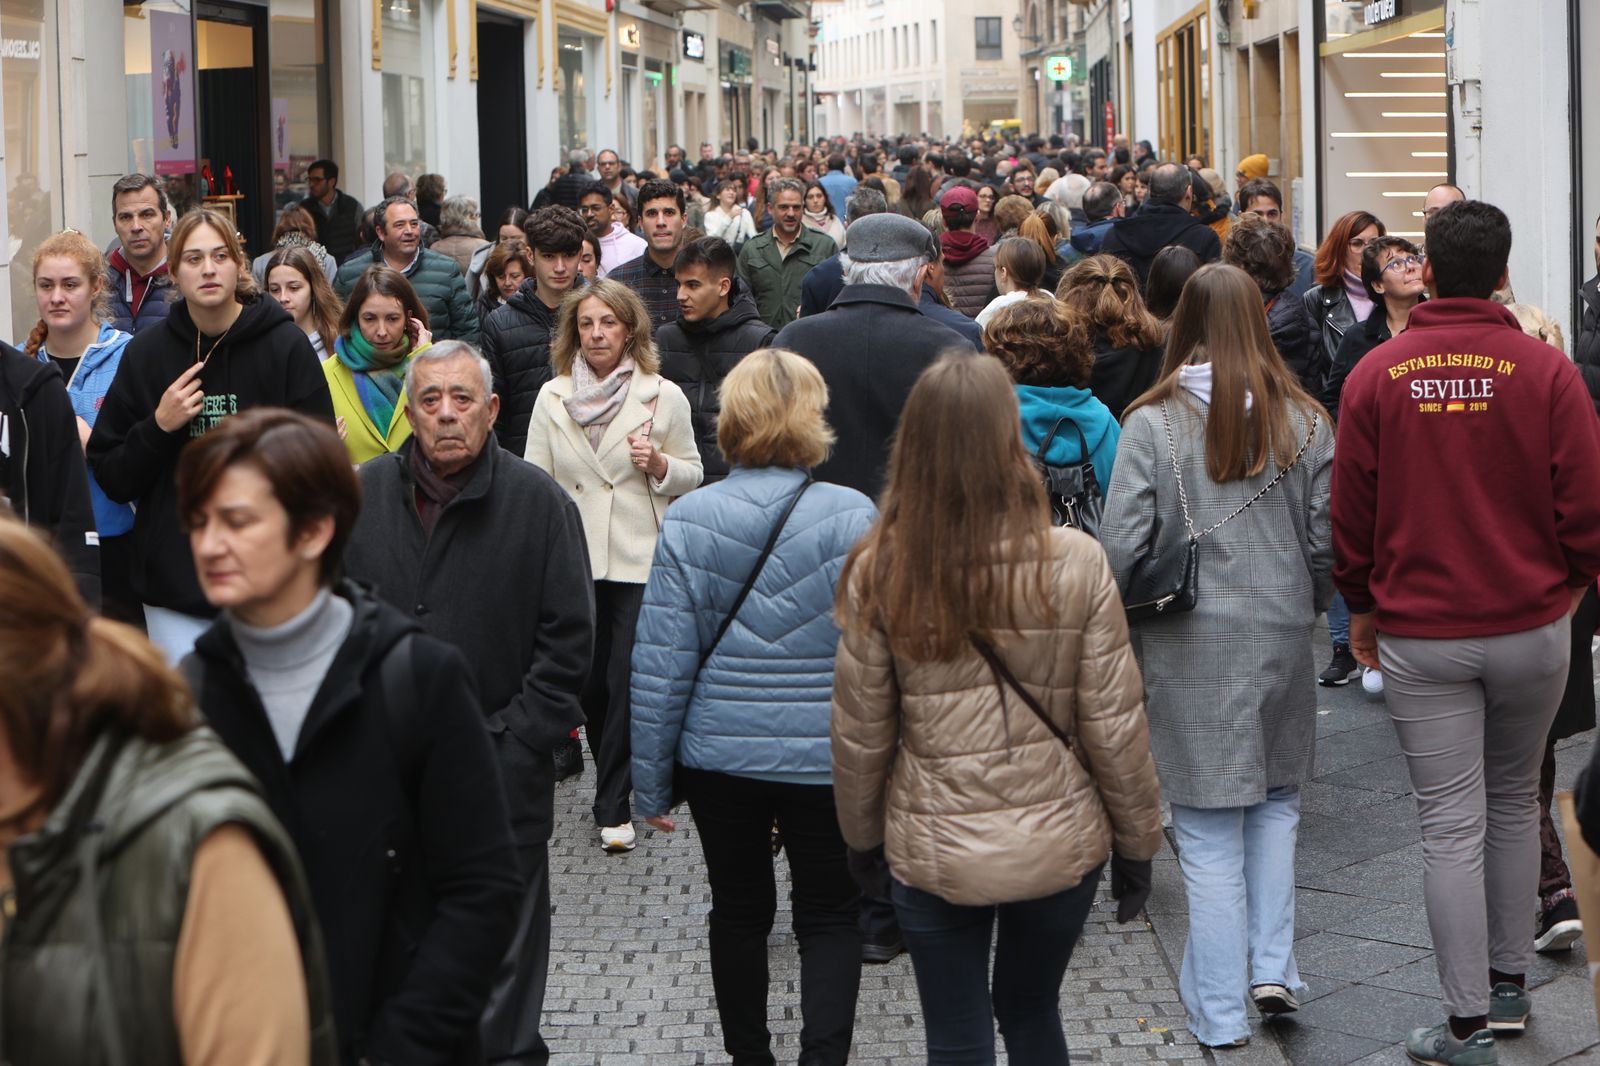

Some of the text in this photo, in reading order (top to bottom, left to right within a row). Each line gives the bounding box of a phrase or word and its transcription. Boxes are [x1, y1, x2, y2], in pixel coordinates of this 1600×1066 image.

[1388, 353, 1516, 380] ESTABLISHED IN
[1410, 378, 1494, 399] SEVILLE
[1419, 402, 1488, 413] SINCE 2019
